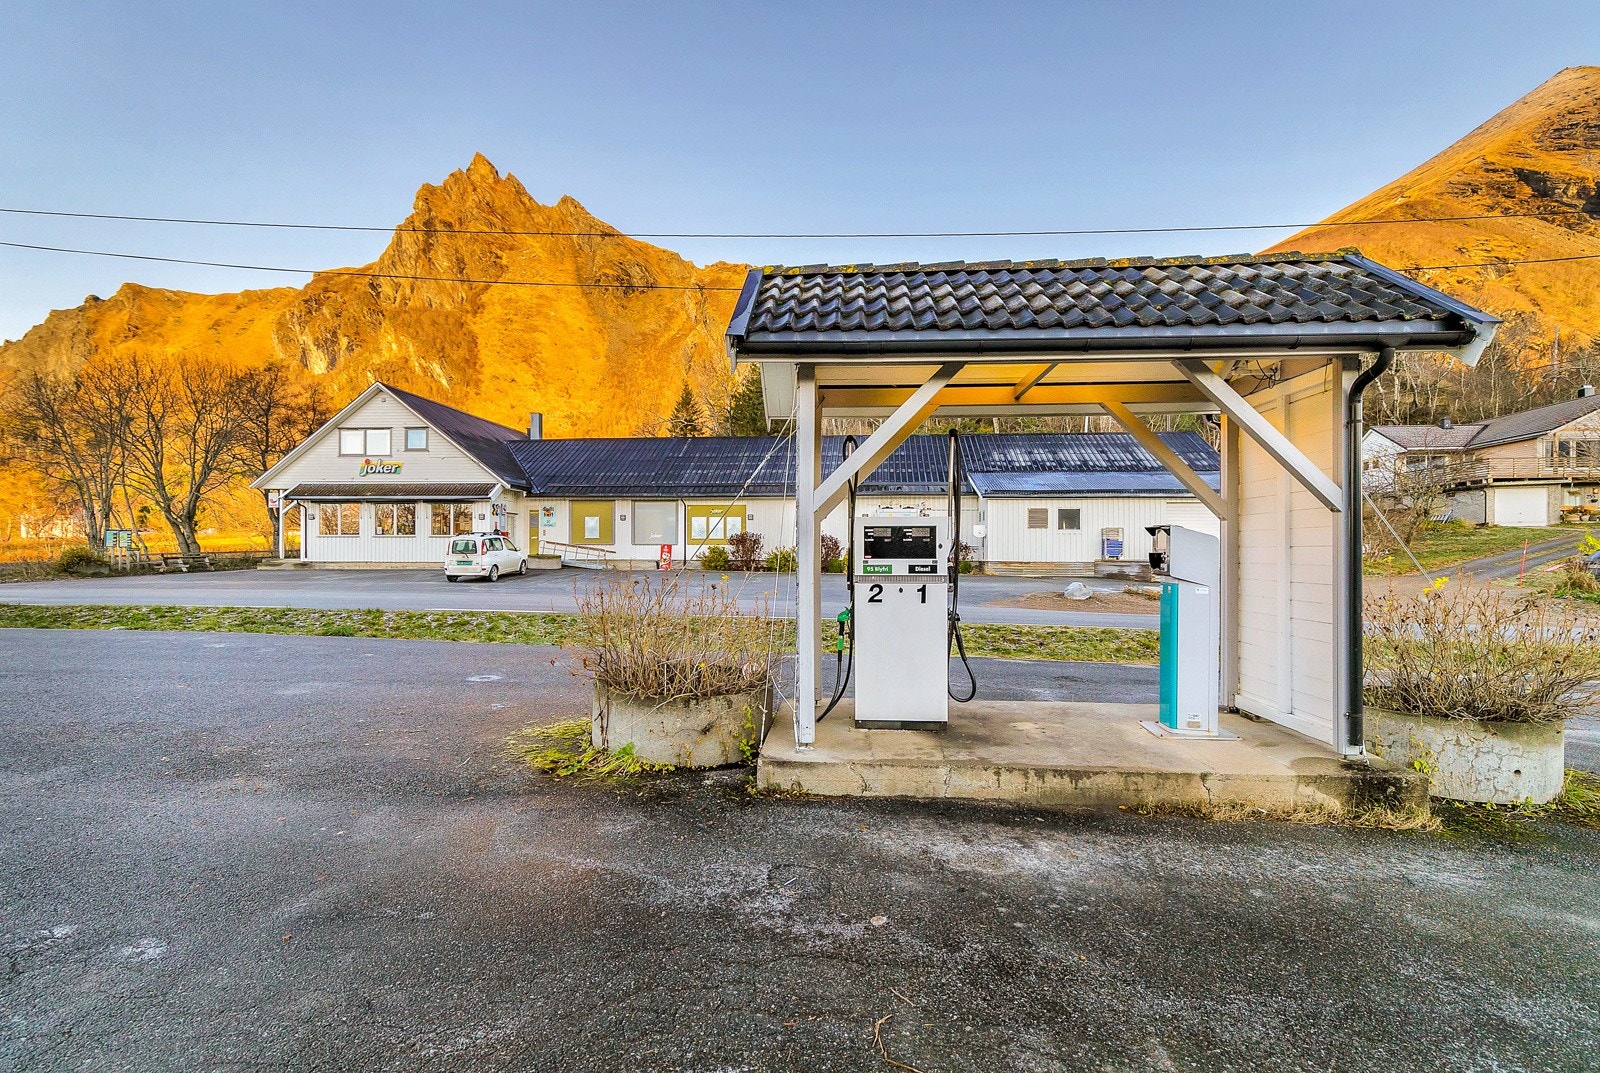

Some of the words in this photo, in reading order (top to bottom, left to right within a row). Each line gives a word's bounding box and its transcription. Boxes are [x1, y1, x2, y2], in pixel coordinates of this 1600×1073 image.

[359, 459, 398, 477] joker
[868, 584, 883, 602] 2
[917, 585, 926, 603] 1
